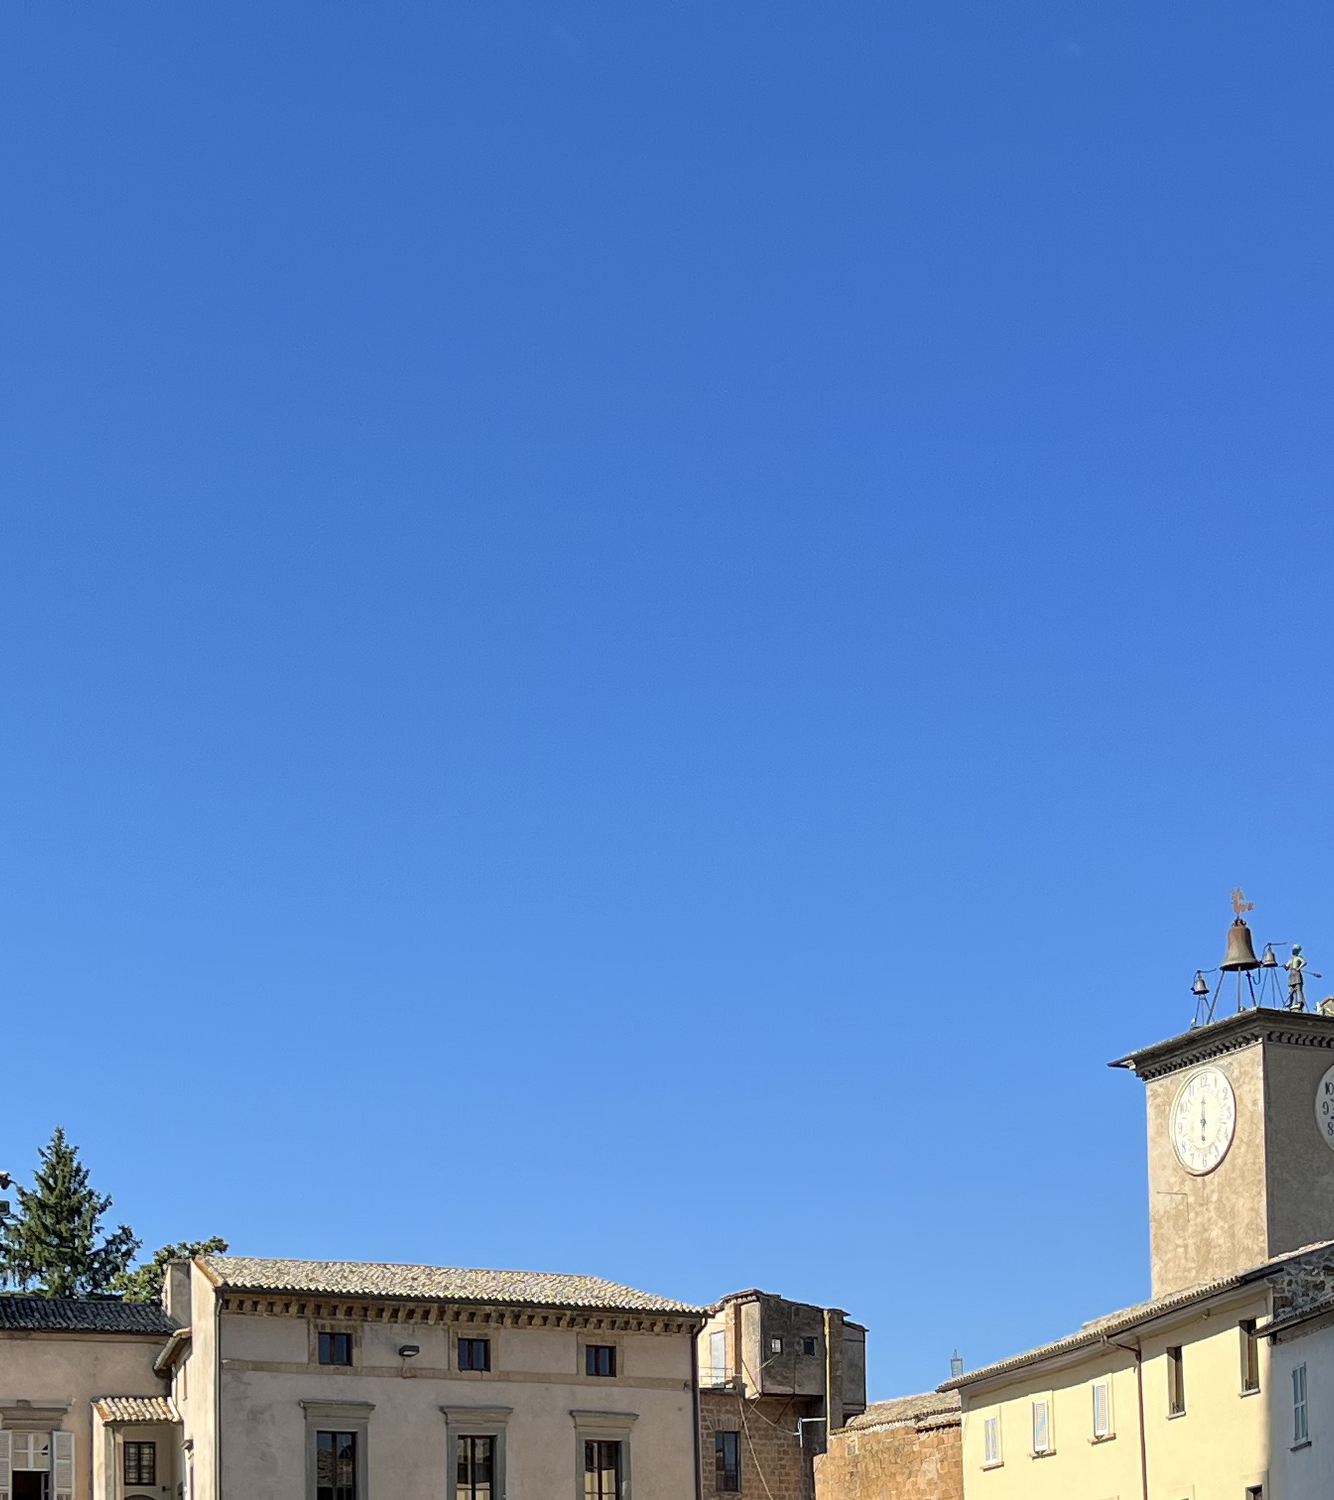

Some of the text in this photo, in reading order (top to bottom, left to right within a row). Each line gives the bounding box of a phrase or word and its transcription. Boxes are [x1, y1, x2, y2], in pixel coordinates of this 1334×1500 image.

[1200, 1074, 1207, 1087] 12
[1222, 1087, 1228, 1100] 2
[1325, 1082, 1334, 1095] 10
[1322, 1102, 1329, 1115] 9
[1327, 1122, 1334, 1136] 8
